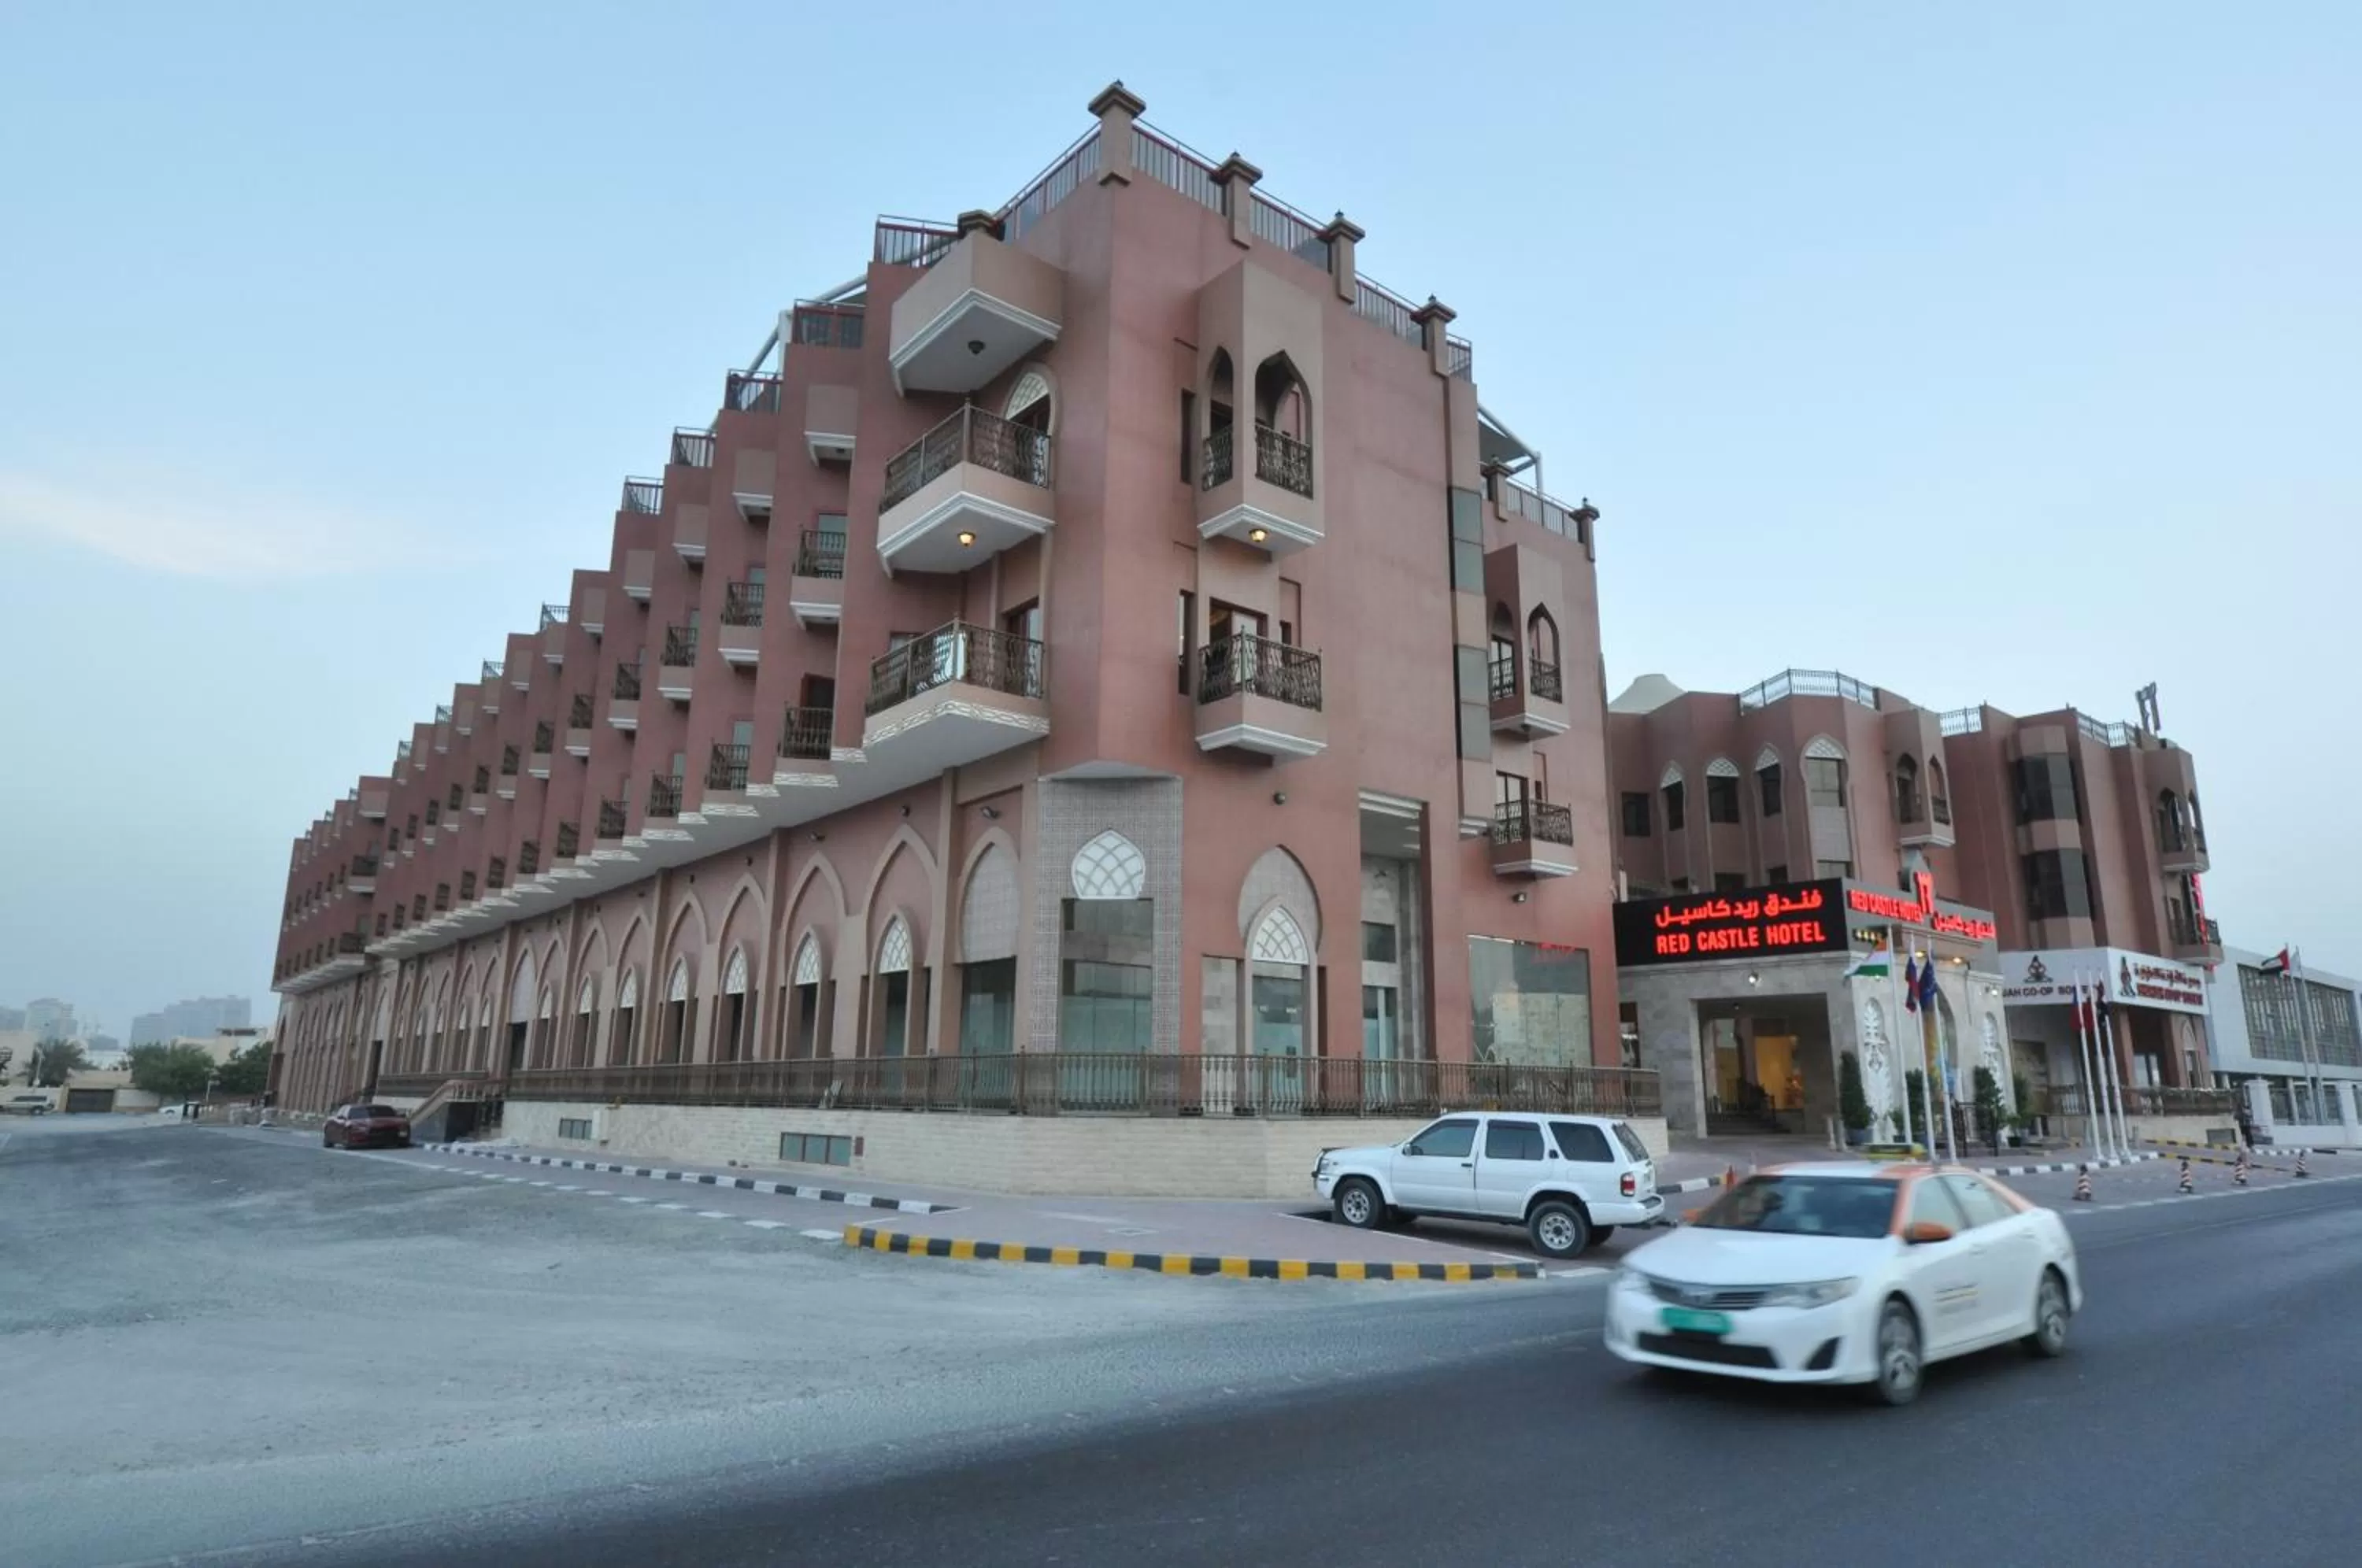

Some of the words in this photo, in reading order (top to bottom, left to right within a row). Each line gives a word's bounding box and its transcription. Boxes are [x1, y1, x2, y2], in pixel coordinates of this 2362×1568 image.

[1764, 889, 1823, 917] فندق
[1848, 889, 1869, 912] RED
[1870, 895, 1899, 918] CASTLE
[1656, 933, 1690, 954] RED
[1697, 926, 1760, 951] CASTLE
[1766, 921, 1826, 945] HOTEL
[2023, 986, 2054, 997] CO-OP
